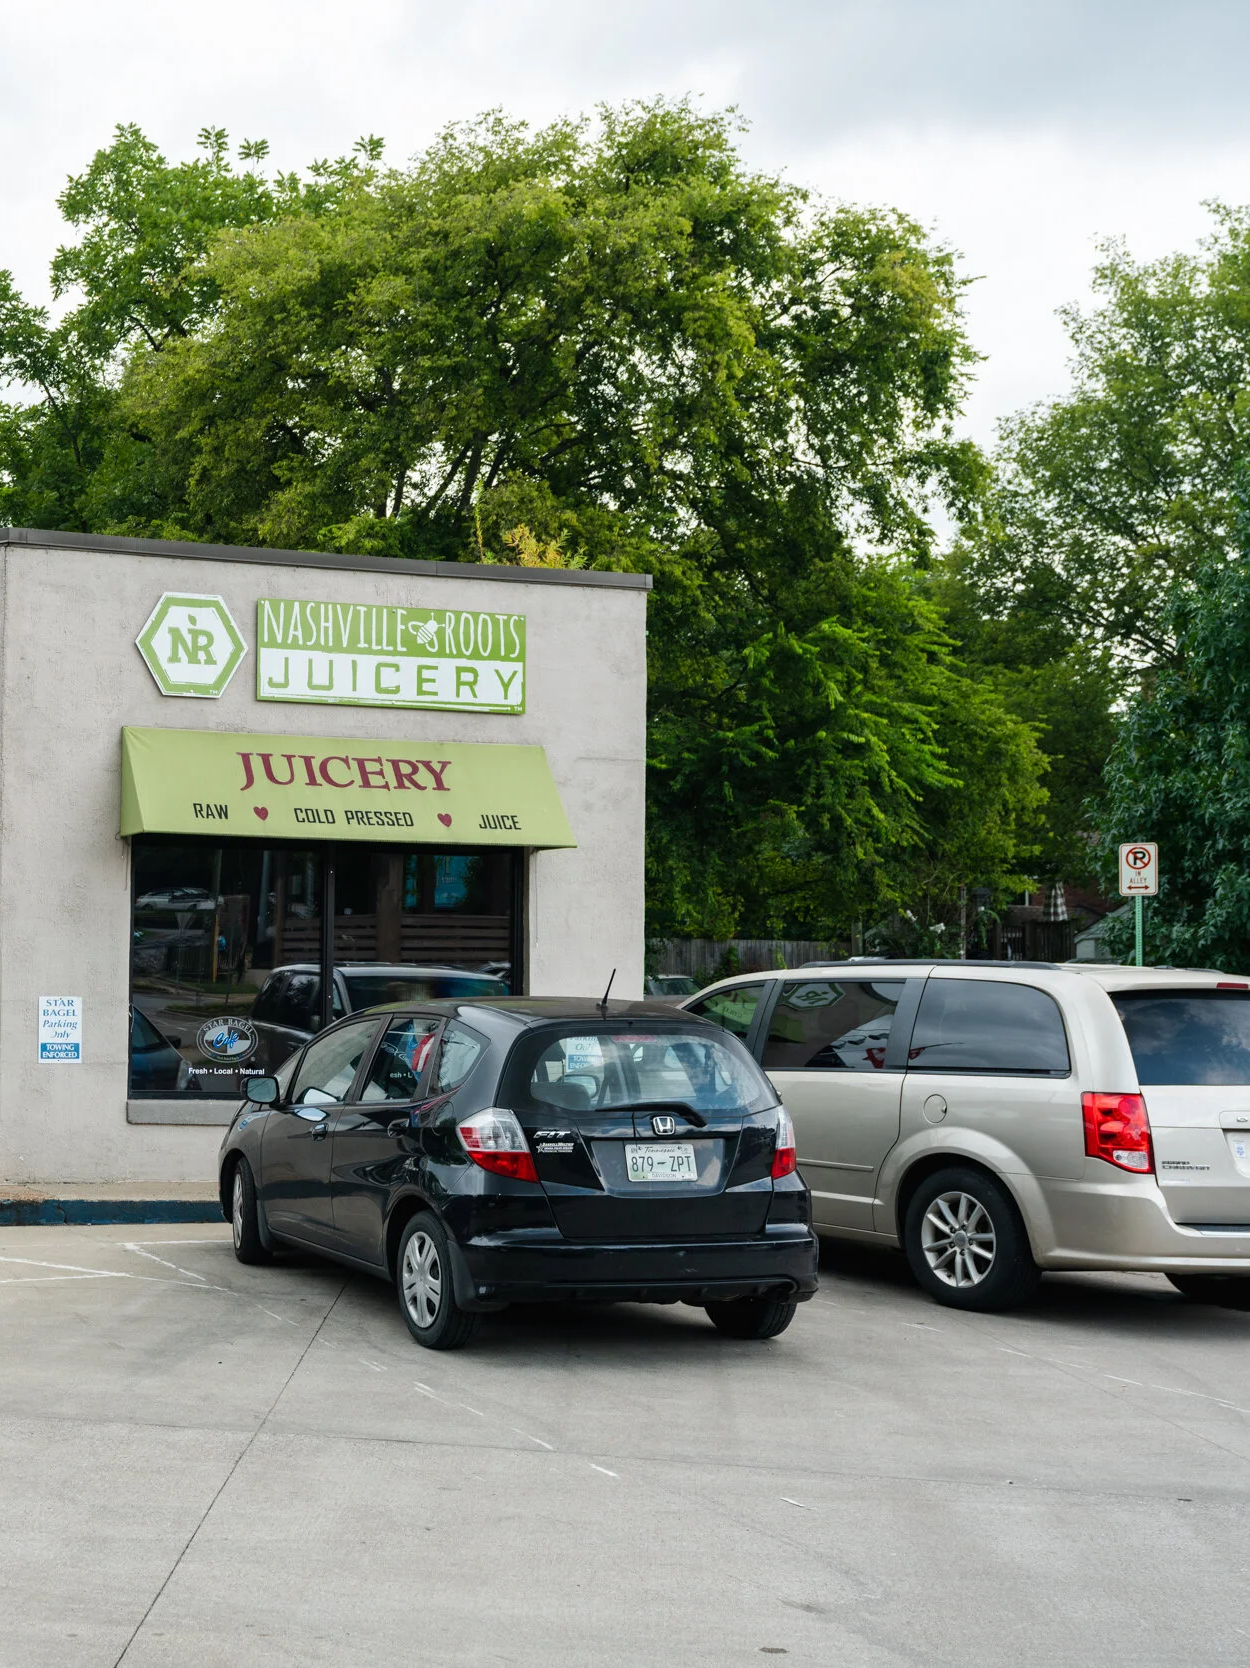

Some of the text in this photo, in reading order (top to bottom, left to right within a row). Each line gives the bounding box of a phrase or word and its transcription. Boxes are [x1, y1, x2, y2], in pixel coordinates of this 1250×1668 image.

[263, 600, 520, 658] NASHVILLE ROOTS
[268, 657, 518, 700] JUICERY
[235, 752, 452, 791] JUICERY
[193, 803, 522, 831] RAW COLD PRESSED JUICE
[1129, 877, 1147, 885] ALLEY
[46, 999, 74, 1007] STAR
[42, 1009, 78, 1017] BAGEL
[42, 1020, 78, 1031] Parking
[203, 1018, 254, 1036] STAR BAGEL
[212, 1030, 240, 1048] Cafe
[45, 1043, 75, 1051] TOWING
[188, 1067, 208, 1075] Fresh
[214, 1067, 233, 1075] Local
[533, 1130, 571, 1138] FIT
[644, 1146, 676, 1154] Tennessee
